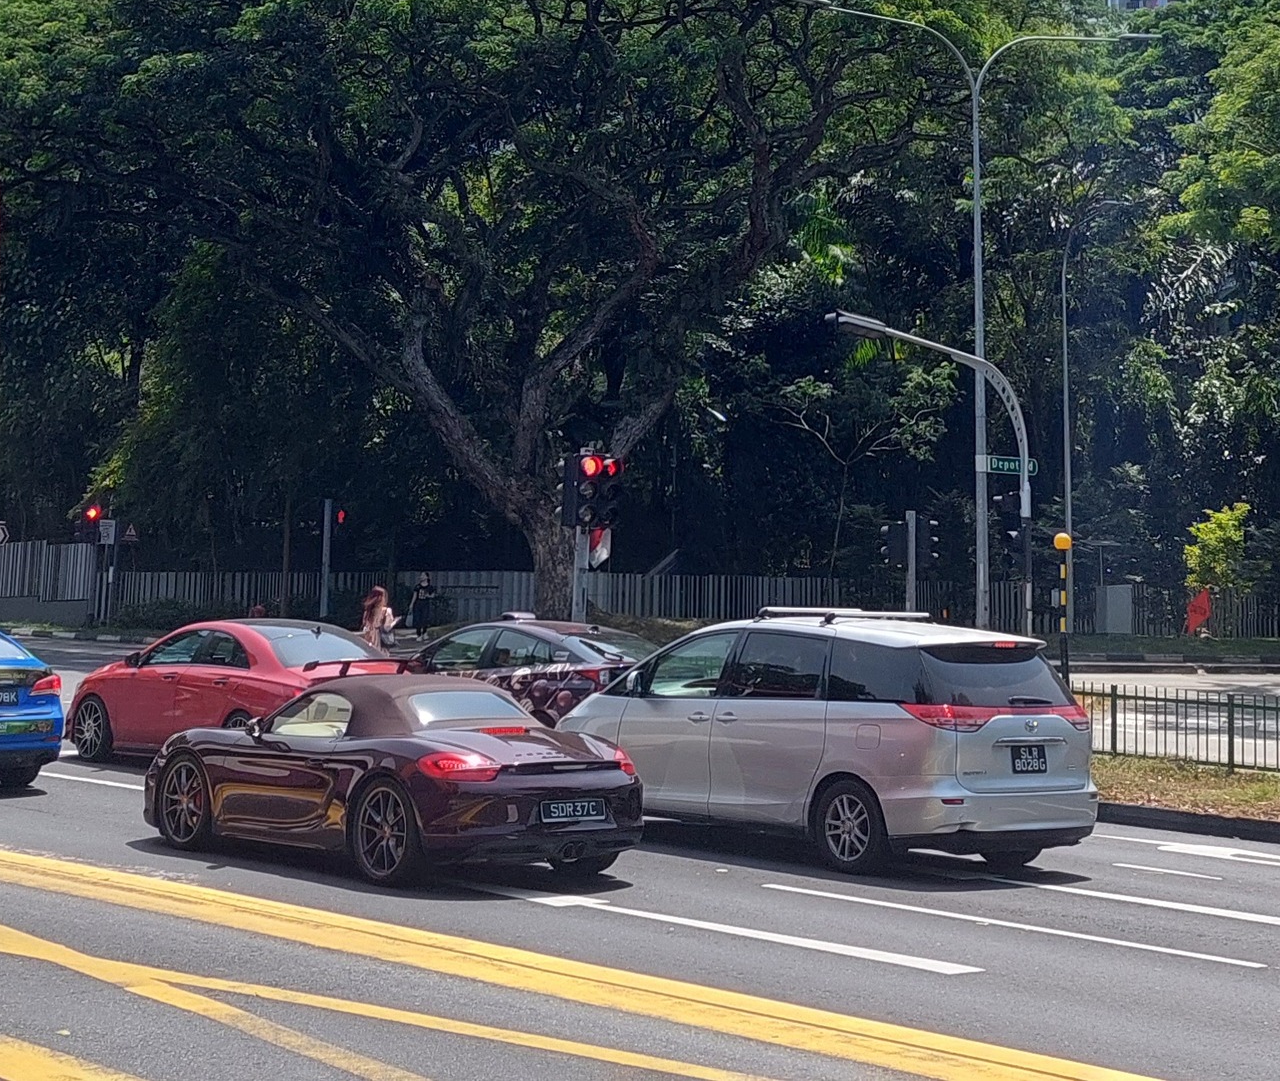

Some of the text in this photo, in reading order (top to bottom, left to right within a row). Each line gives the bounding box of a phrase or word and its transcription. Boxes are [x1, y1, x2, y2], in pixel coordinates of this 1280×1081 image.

[992, 458, 1019, 471] Depot
[1020, 747, 1038, 759] SLR
[1014, 759, 1046, 771] 8028G
